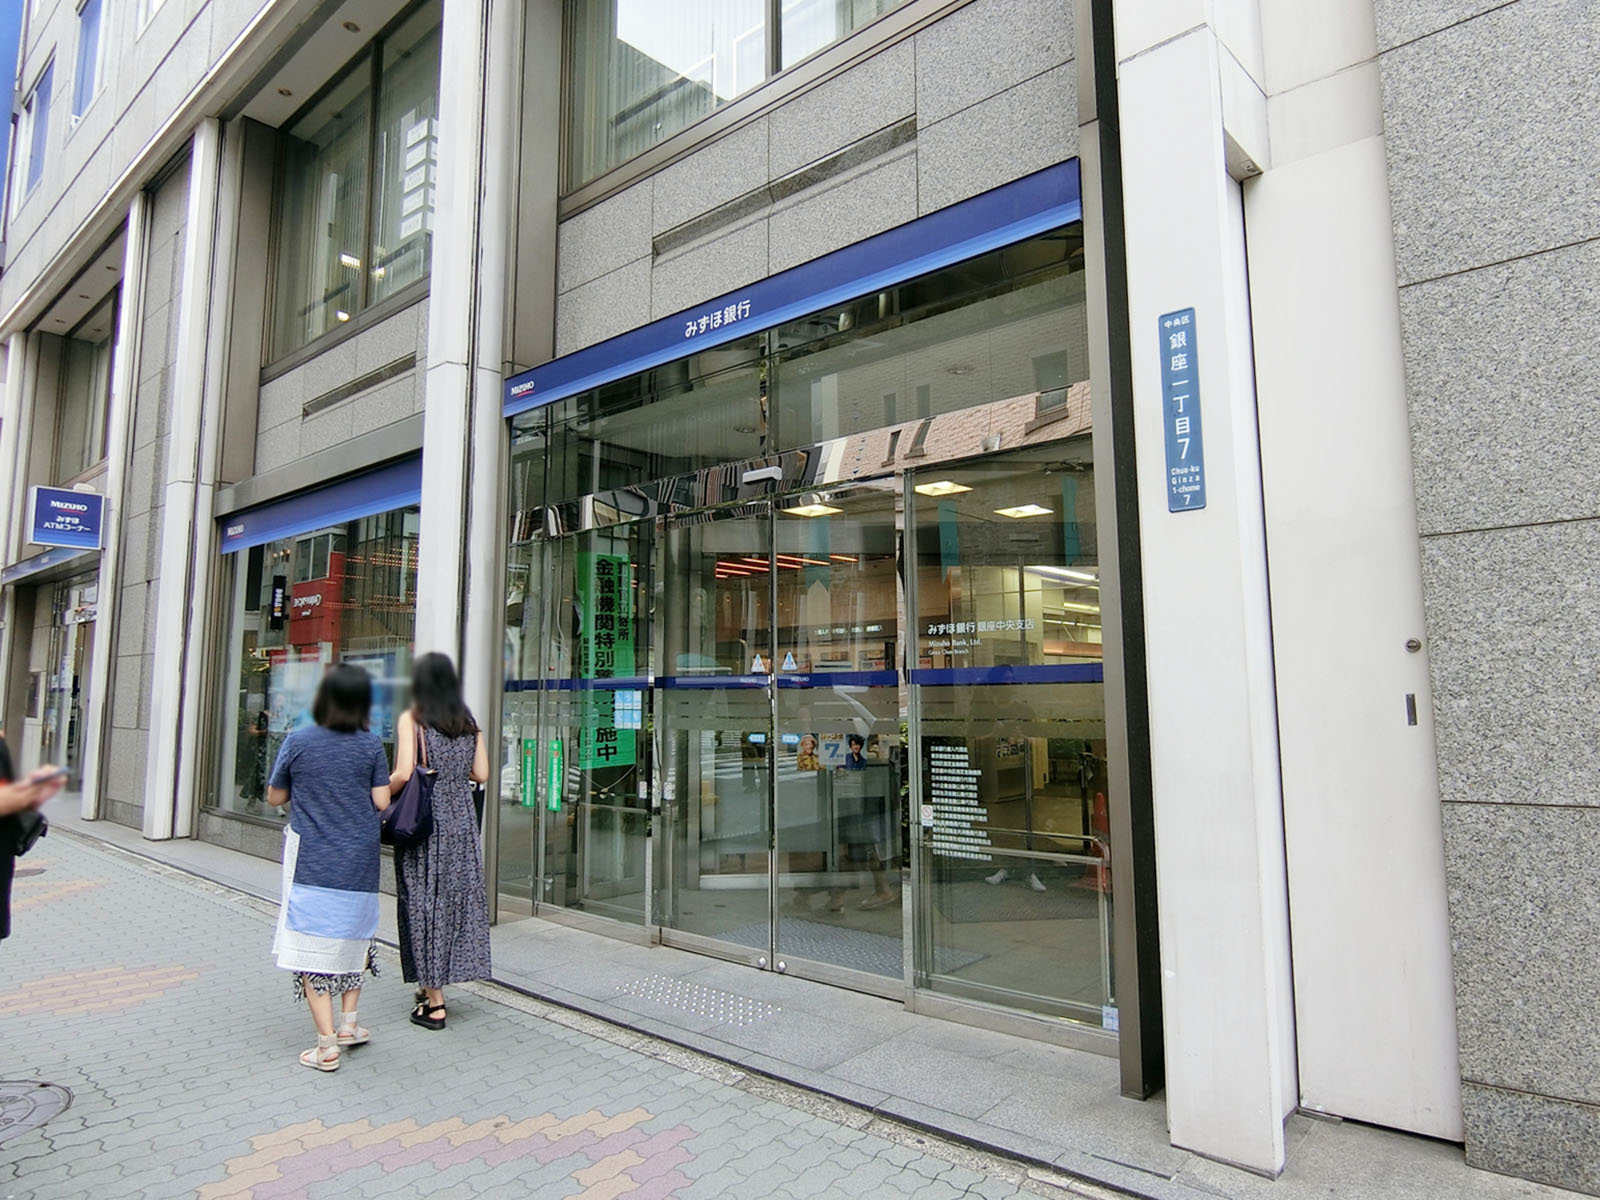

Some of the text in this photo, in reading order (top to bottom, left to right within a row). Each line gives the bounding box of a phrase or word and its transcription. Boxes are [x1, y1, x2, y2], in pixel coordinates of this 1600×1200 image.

[685, 300, 751, 338] みずほ銀行
[1164, 315, 1190, 328] 中央区
[510, 380, 535, 396] MIZUHO
[1171, 465, 1200, 476] Chuo-ku
[1172, 475, 1200, 485] Ginza
[1173, 484, 1201, 494] 1-chome
[50, 500, 88, 511] MIZUHO
[1184, 495, 1191, 505] 7
[56, 515, 80, 524] みずほ
[43, 521, 91, 532] ATMコーナー
[927, 618, 1035, 635] みずほ銀行 銀座中央支店
[928, 640, 951, 648] Mizuho
[970, 638, 983, 646] Ltd.
